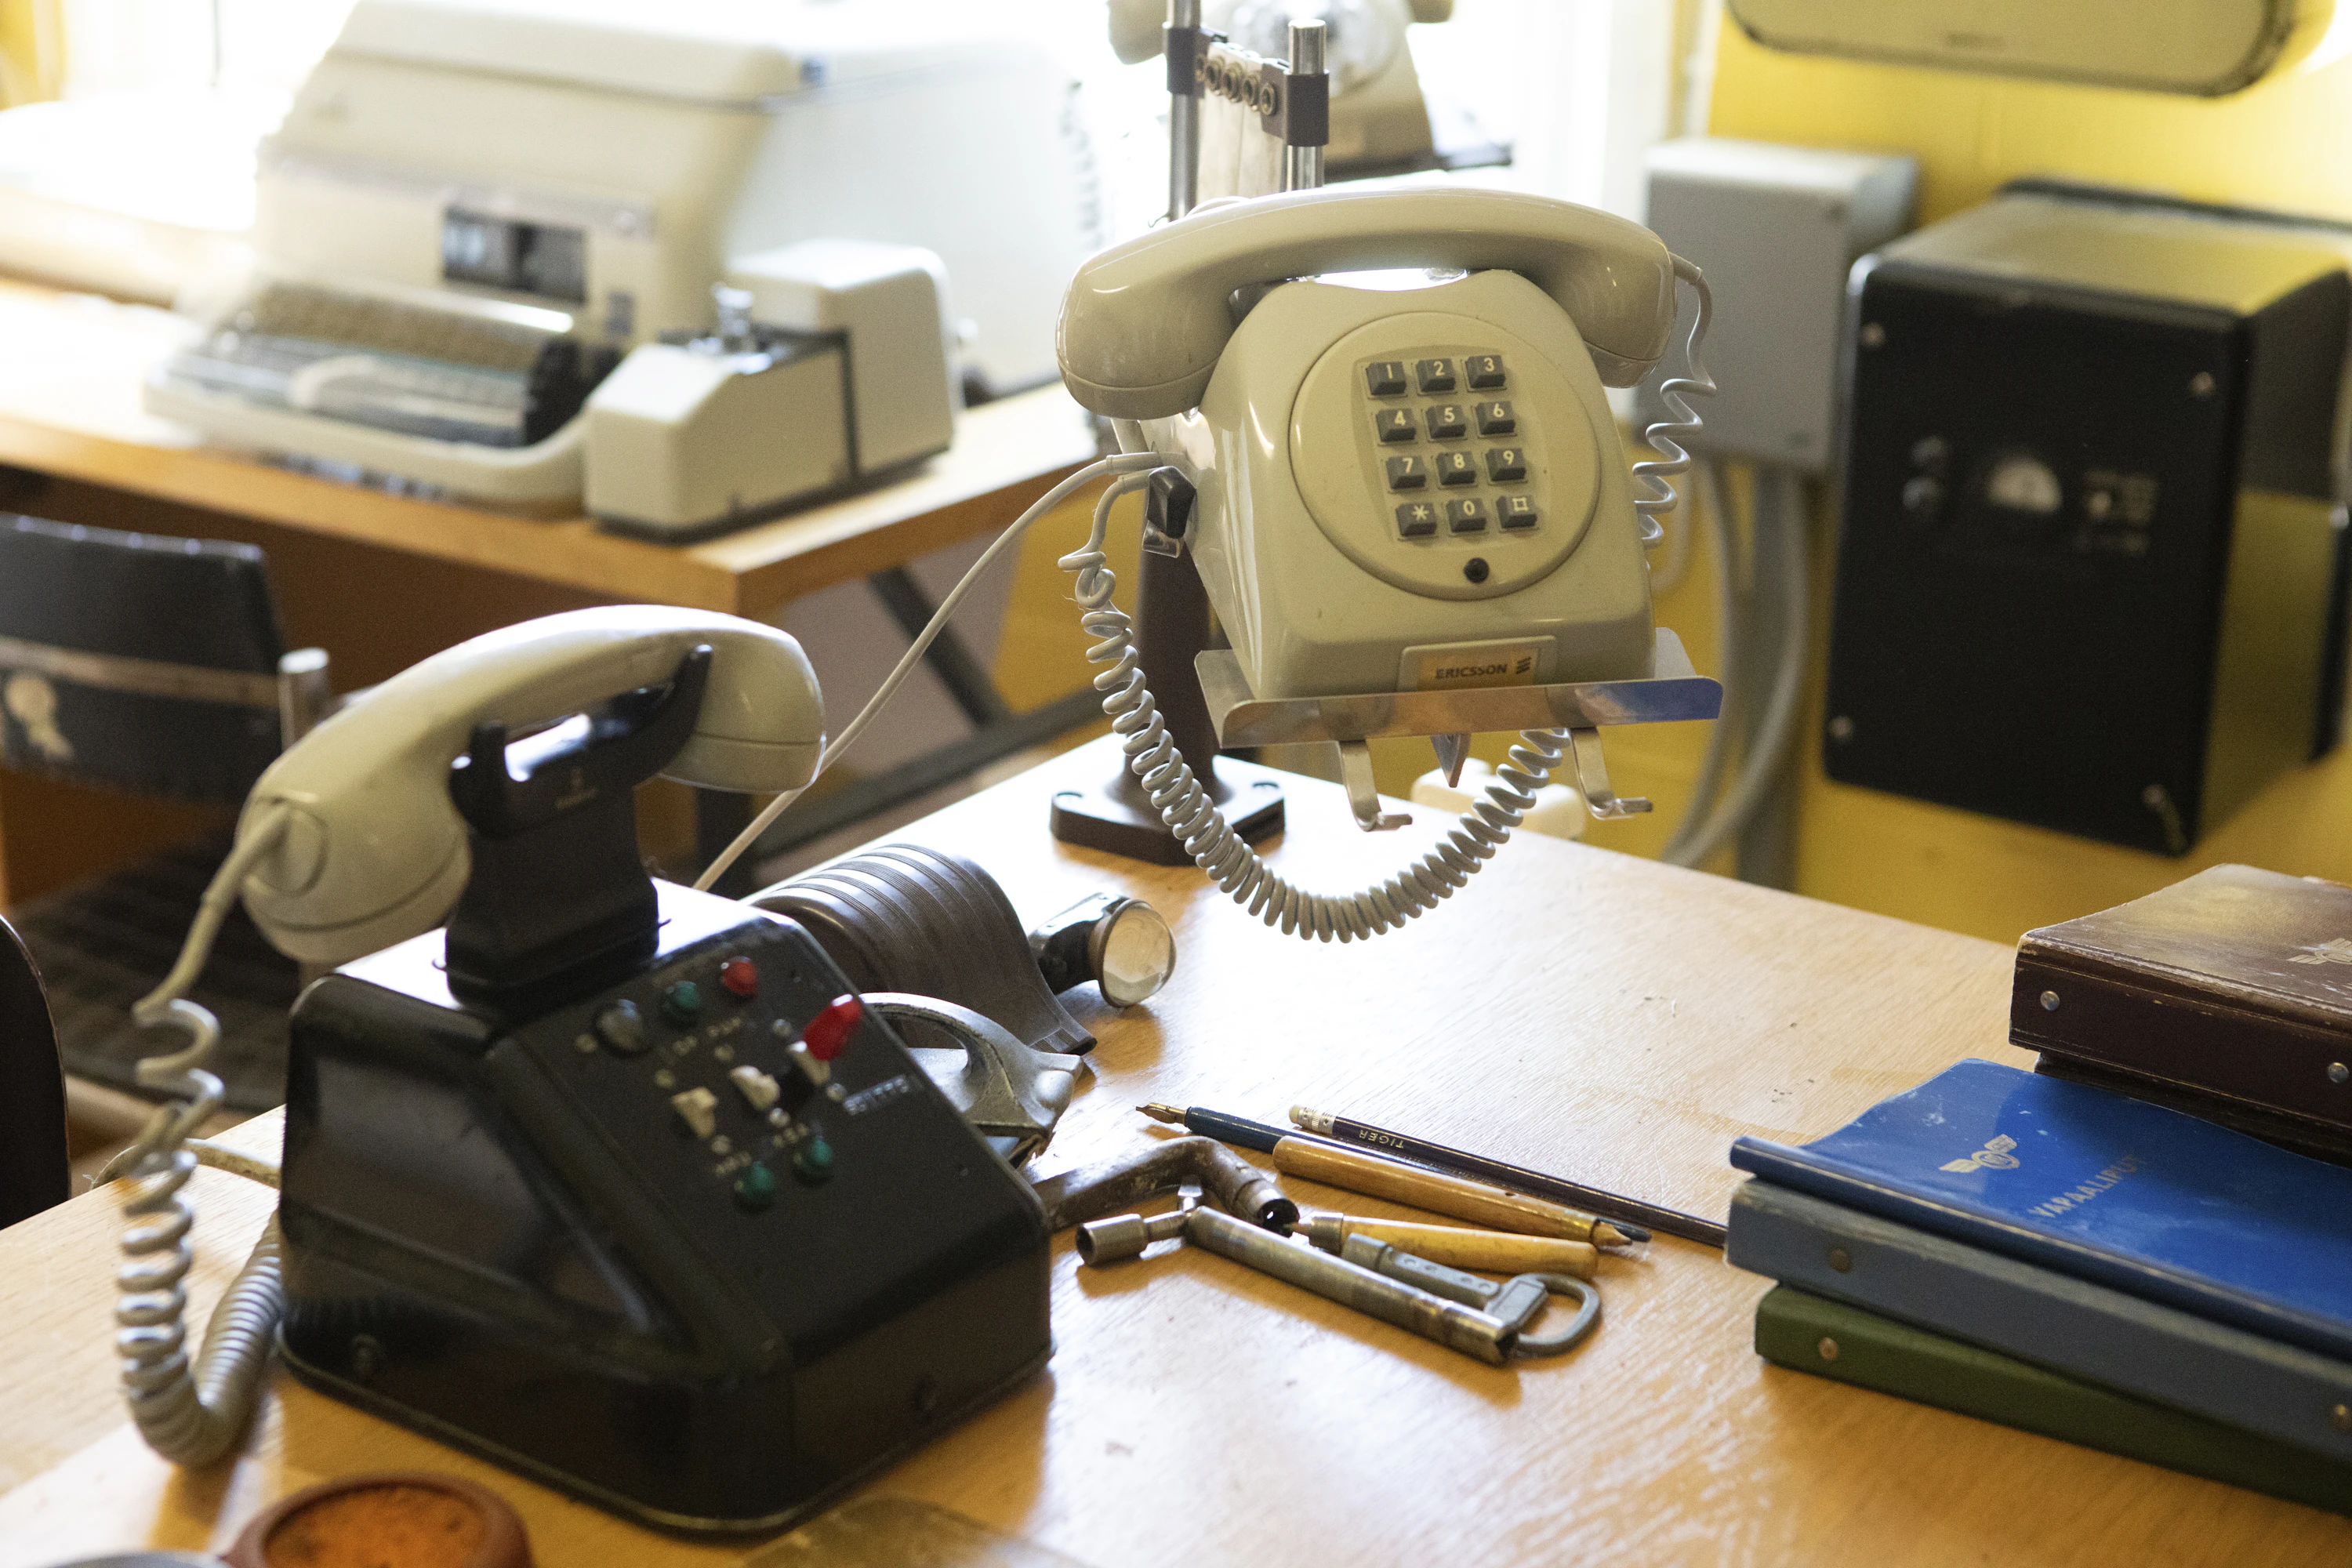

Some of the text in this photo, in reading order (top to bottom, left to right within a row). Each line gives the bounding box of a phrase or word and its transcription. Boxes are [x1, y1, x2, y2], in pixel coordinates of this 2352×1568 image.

[1386, 358, 1495, 379] 1 2 3
[1394, 403, 1504, 426] 4 5 6
[1402, 450, 1515, 473] 7 8 9
[1463, 500, 1475, 516] 0
[1436, 664, 1508, 680] ERICSSON
[1359, 1129, 1406, 1149] TIGER
